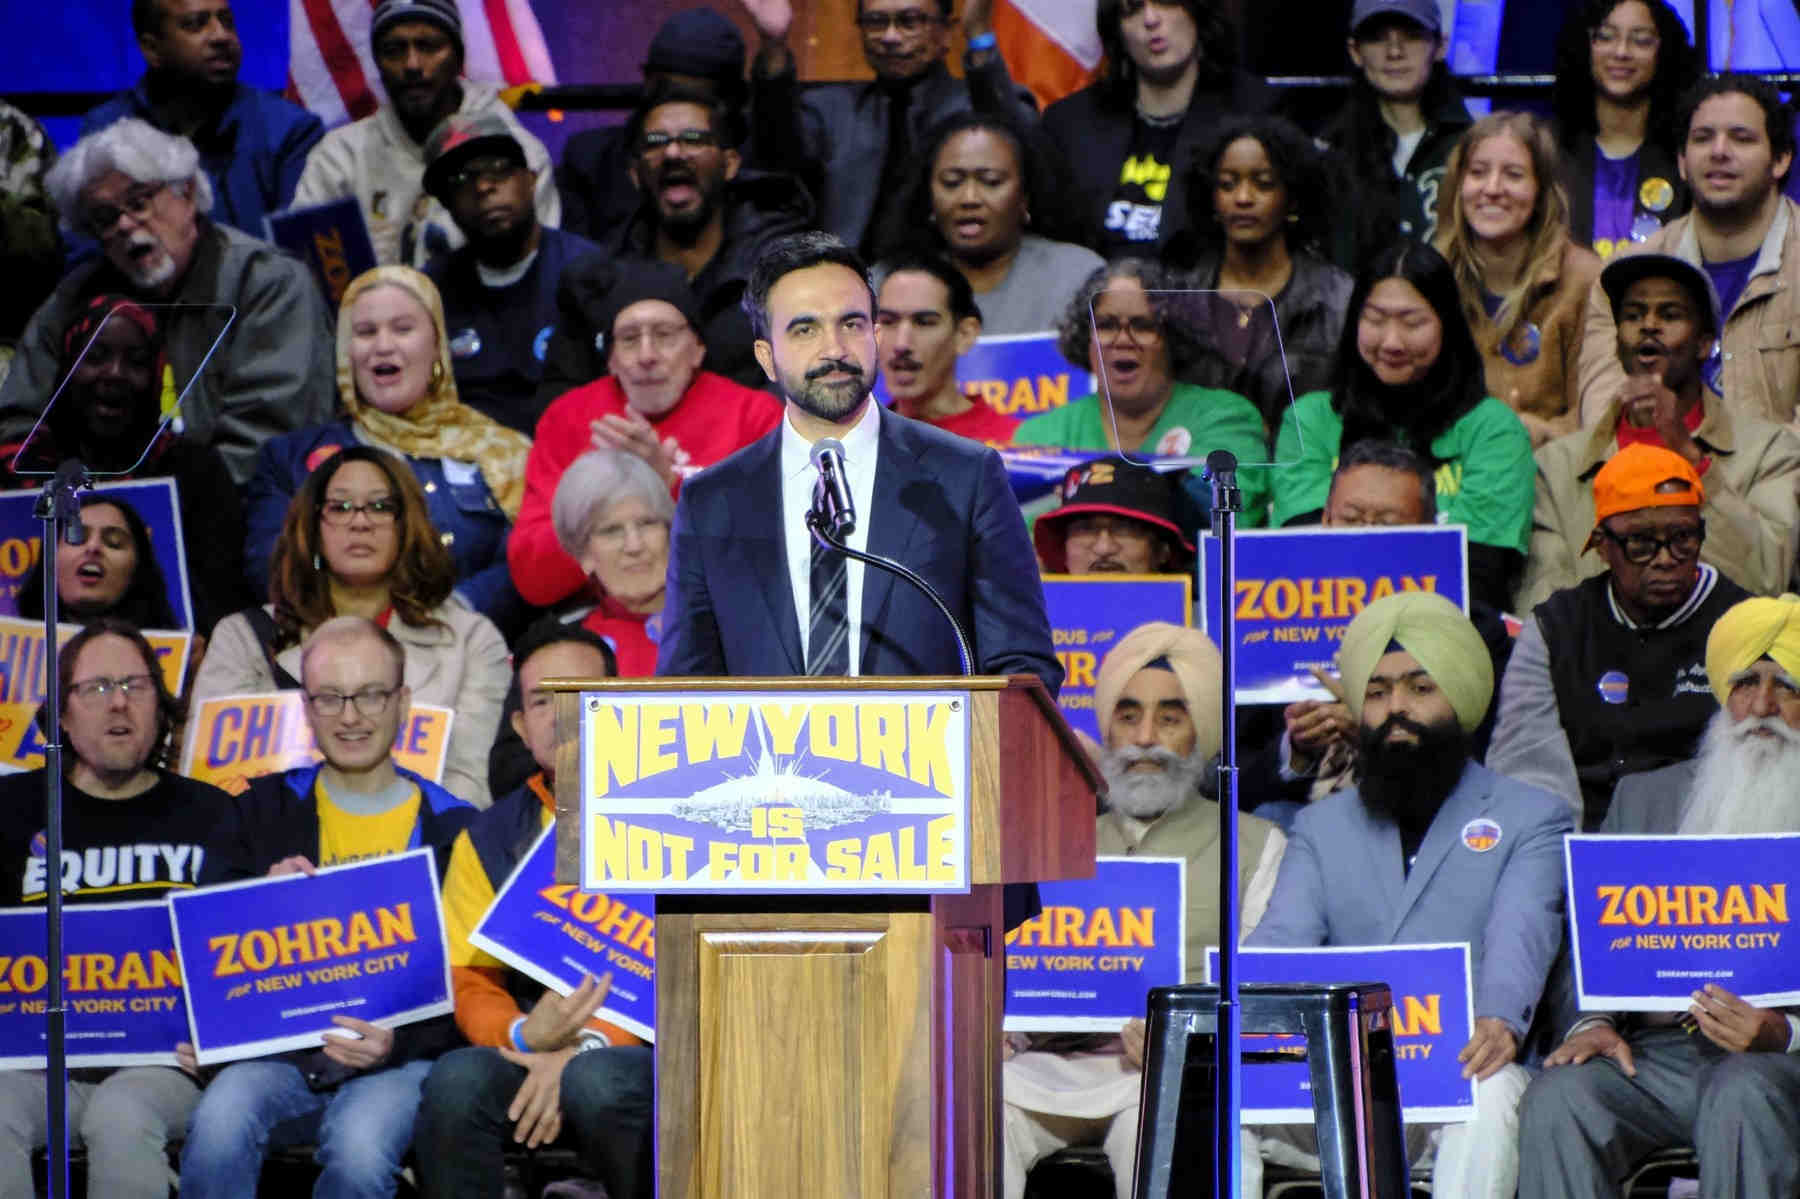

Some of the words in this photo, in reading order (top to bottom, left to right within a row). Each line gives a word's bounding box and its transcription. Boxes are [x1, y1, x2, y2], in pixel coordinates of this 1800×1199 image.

[1273, 626, 1319, 642] NEW
[593, 703, 754, 799] NEW
[758, 703, 954, 799] YORK
[751, 806, 804, 839] IS
[594, 813, 695, 880] NOT
[708, 840, 810, 880] FOR
[825, 813, 957, 880] SALE
[22, 844, 204, 896] EQUITY!
[1596, 883, 1790, 926] ZOHRAN
[209, 902, 417, 978] ZOHRAN
[561, 921, 607, 953] NEW
[606, 948, 655, 982] YORK
[1636, 933, 1677, 950] NEW
[1681, 933, 1732, 950] YORK
[1735, 932, 1781, 949] CITY
[256, 973, 302, 993] NEW
[306, 961, 362, 986] YORK
[364, 951, 409, 975] CITY
[1044, 955, 1095, 971] YORK
[1098, 956, 1145, 972] CITY
[73, 999, 126, 1014] YORK
[130, 997, 177, 1012] CITY
